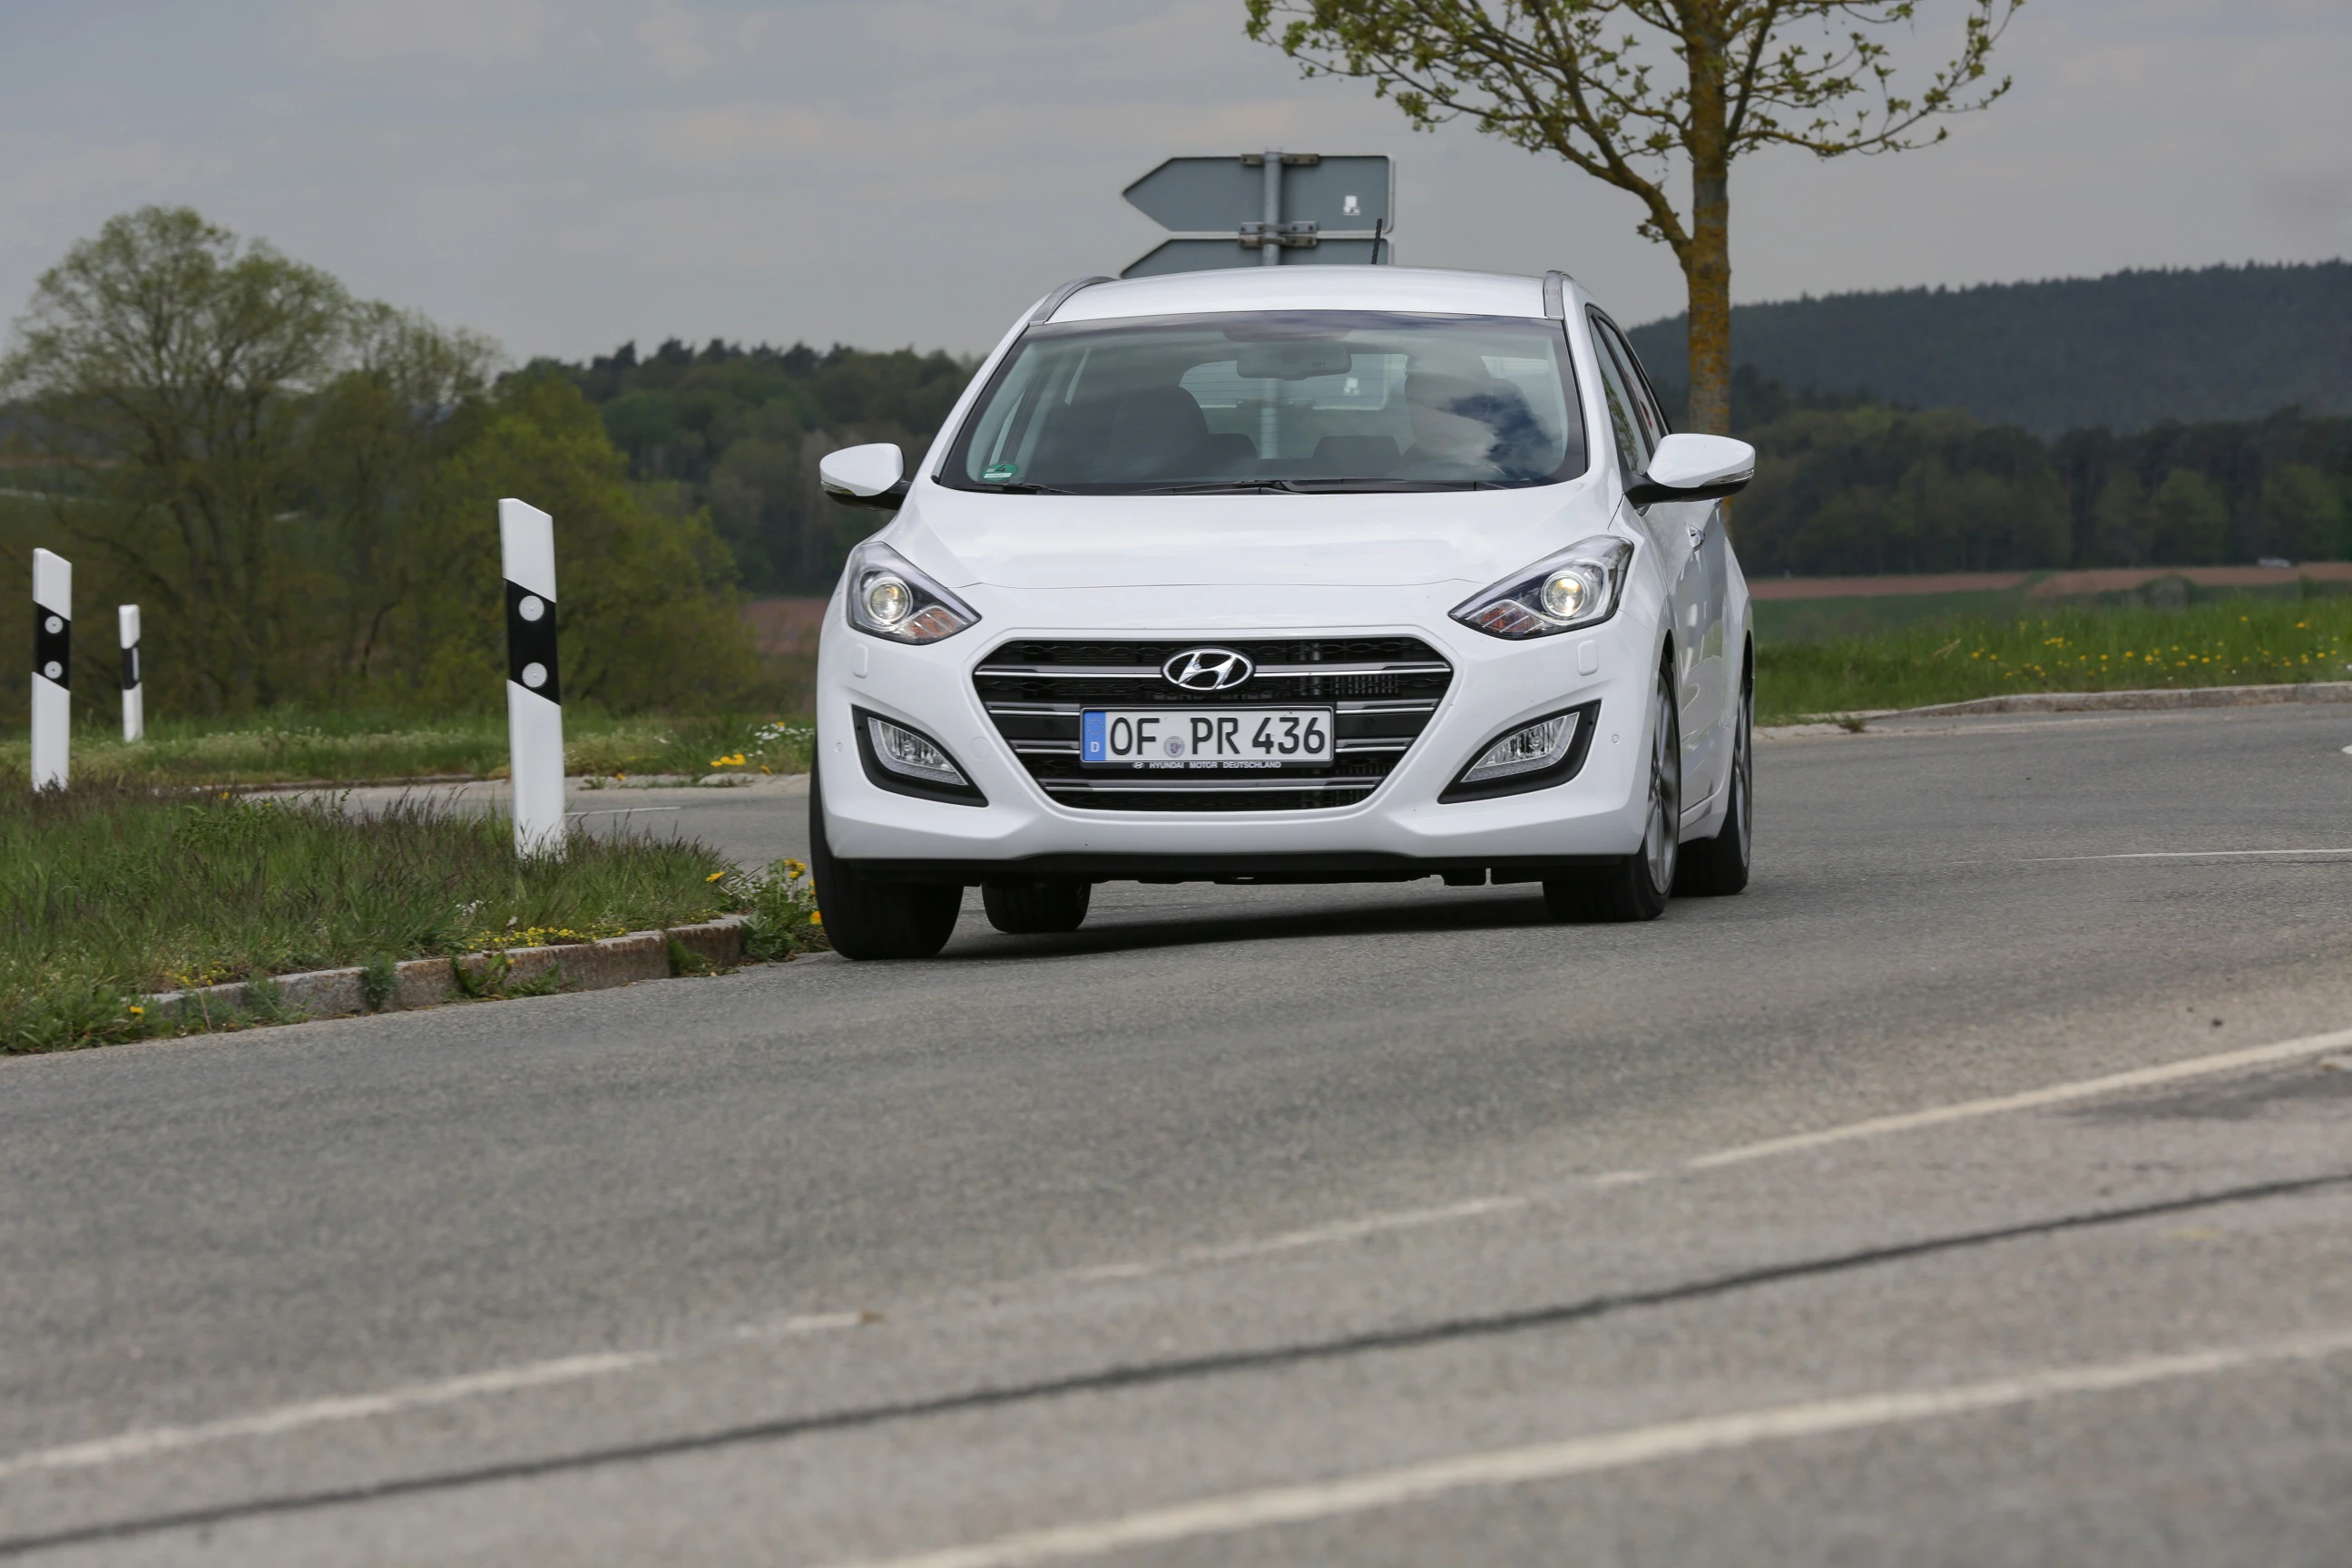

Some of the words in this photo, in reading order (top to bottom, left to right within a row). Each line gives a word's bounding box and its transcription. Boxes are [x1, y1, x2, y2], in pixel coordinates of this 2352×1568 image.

[1090, 741, 1100, 752] D
[1110, 717, 1160, 755] OF
[1191, 717, 1240, 755] PR
[1251, 717, 1326, 755] 436
